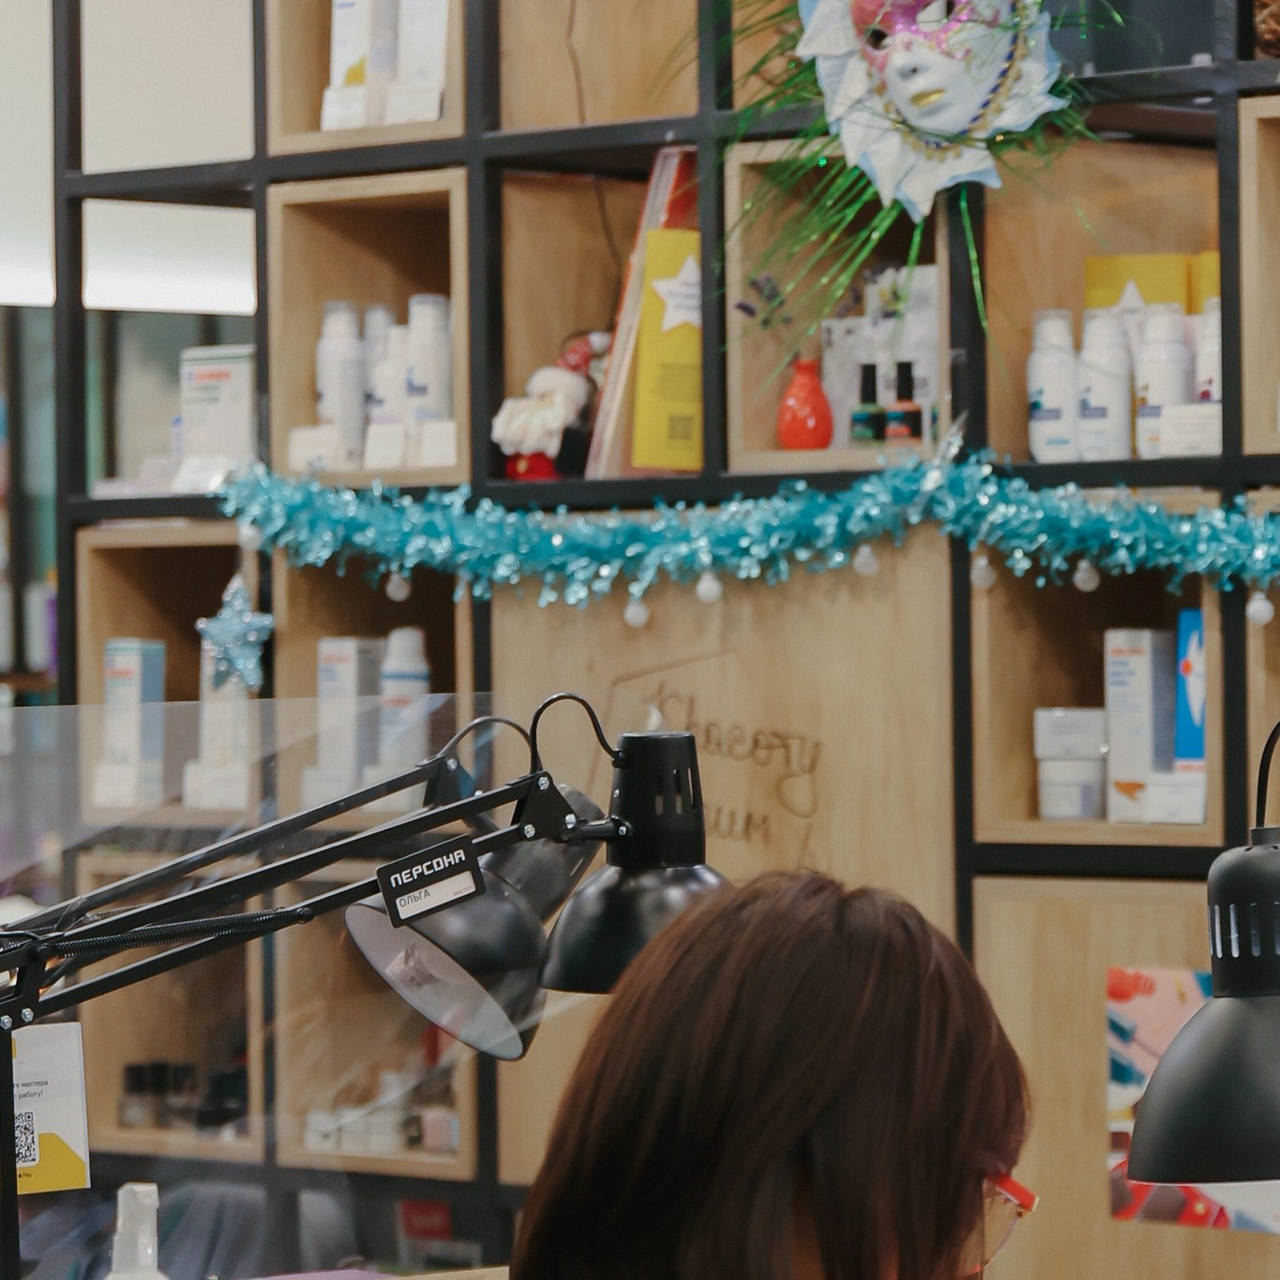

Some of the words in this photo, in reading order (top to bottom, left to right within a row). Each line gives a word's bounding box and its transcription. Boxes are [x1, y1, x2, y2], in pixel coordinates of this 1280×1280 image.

[390, 849, 466, 888] ПЕРСОНА
[400, 889, 431, 907] ОЛЬГА
[21, 1080, 49, 1088] мастера
[18, 1090, 43, 1100] работу!
